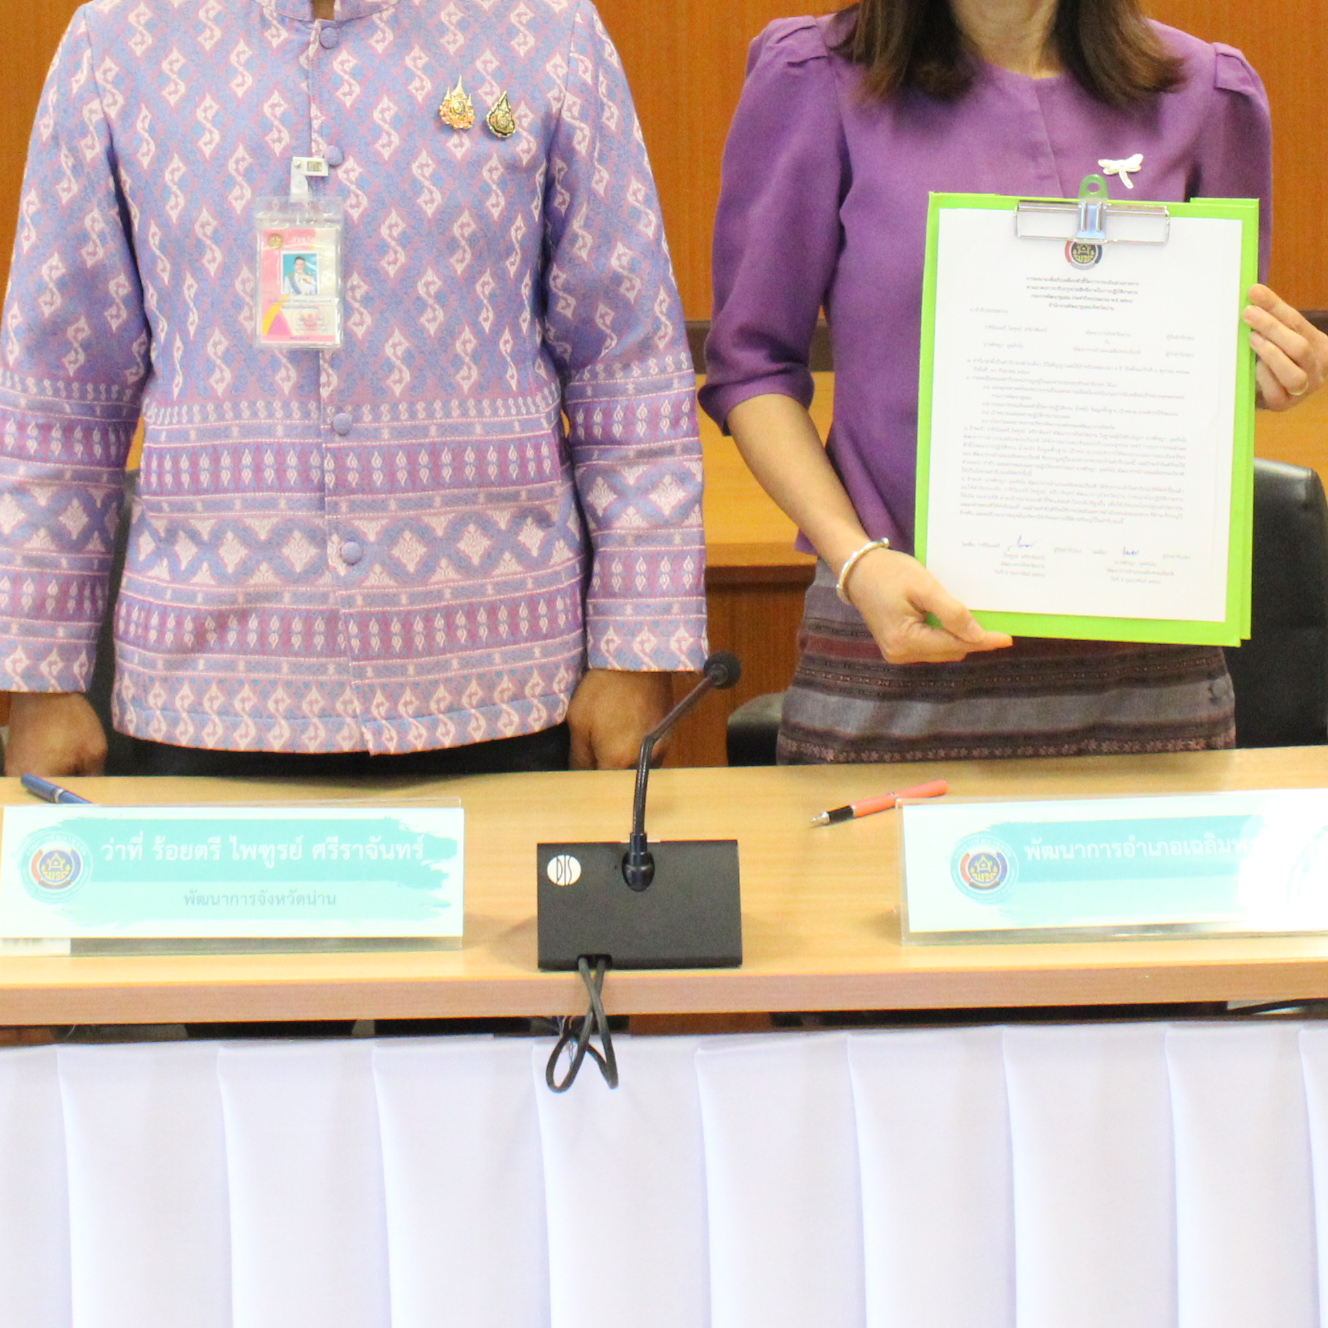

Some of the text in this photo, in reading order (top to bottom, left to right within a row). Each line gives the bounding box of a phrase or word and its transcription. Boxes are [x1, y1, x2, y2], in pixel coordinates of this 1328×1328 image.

[100, 831, 144, 861] ว่าที่
[151, 835, 222, 861] ร้อยตรี
[229, 834, 305, 869] ไพฑูรย์
[311, 833, 425, 860] ศรีราจันทร์
[183, 888, 337, 907] พัฒนาการจังหวัดน่าน
